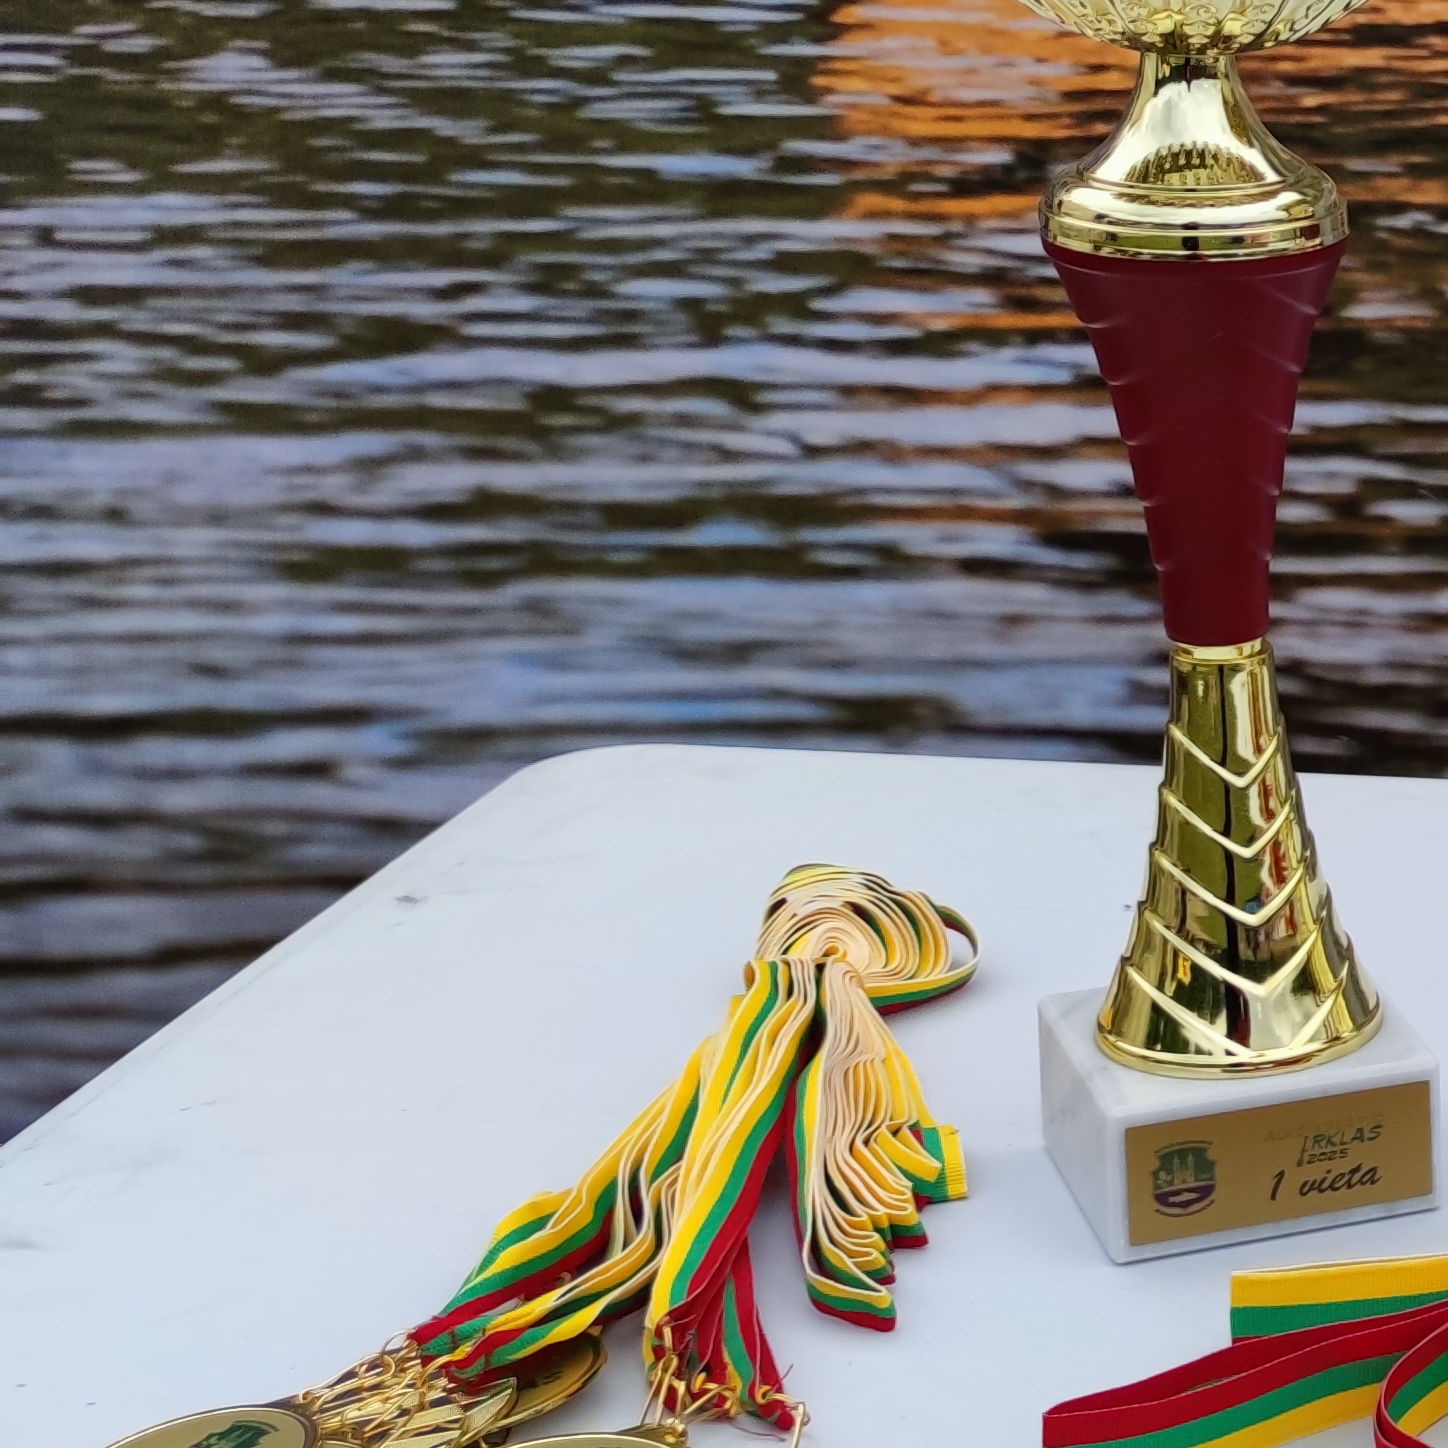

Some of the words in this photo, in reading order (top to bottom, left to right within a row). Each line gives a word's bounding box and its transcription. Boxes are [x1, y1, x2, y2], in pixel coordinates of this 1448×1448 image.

[1296, 1124, 1384, 1167] IRKLAS
[1306, 1148, 1351, 1165] 2025
[1270, 1169, 1286, 1202] 1
[1299, 1162, 1382, 1197] vieta
